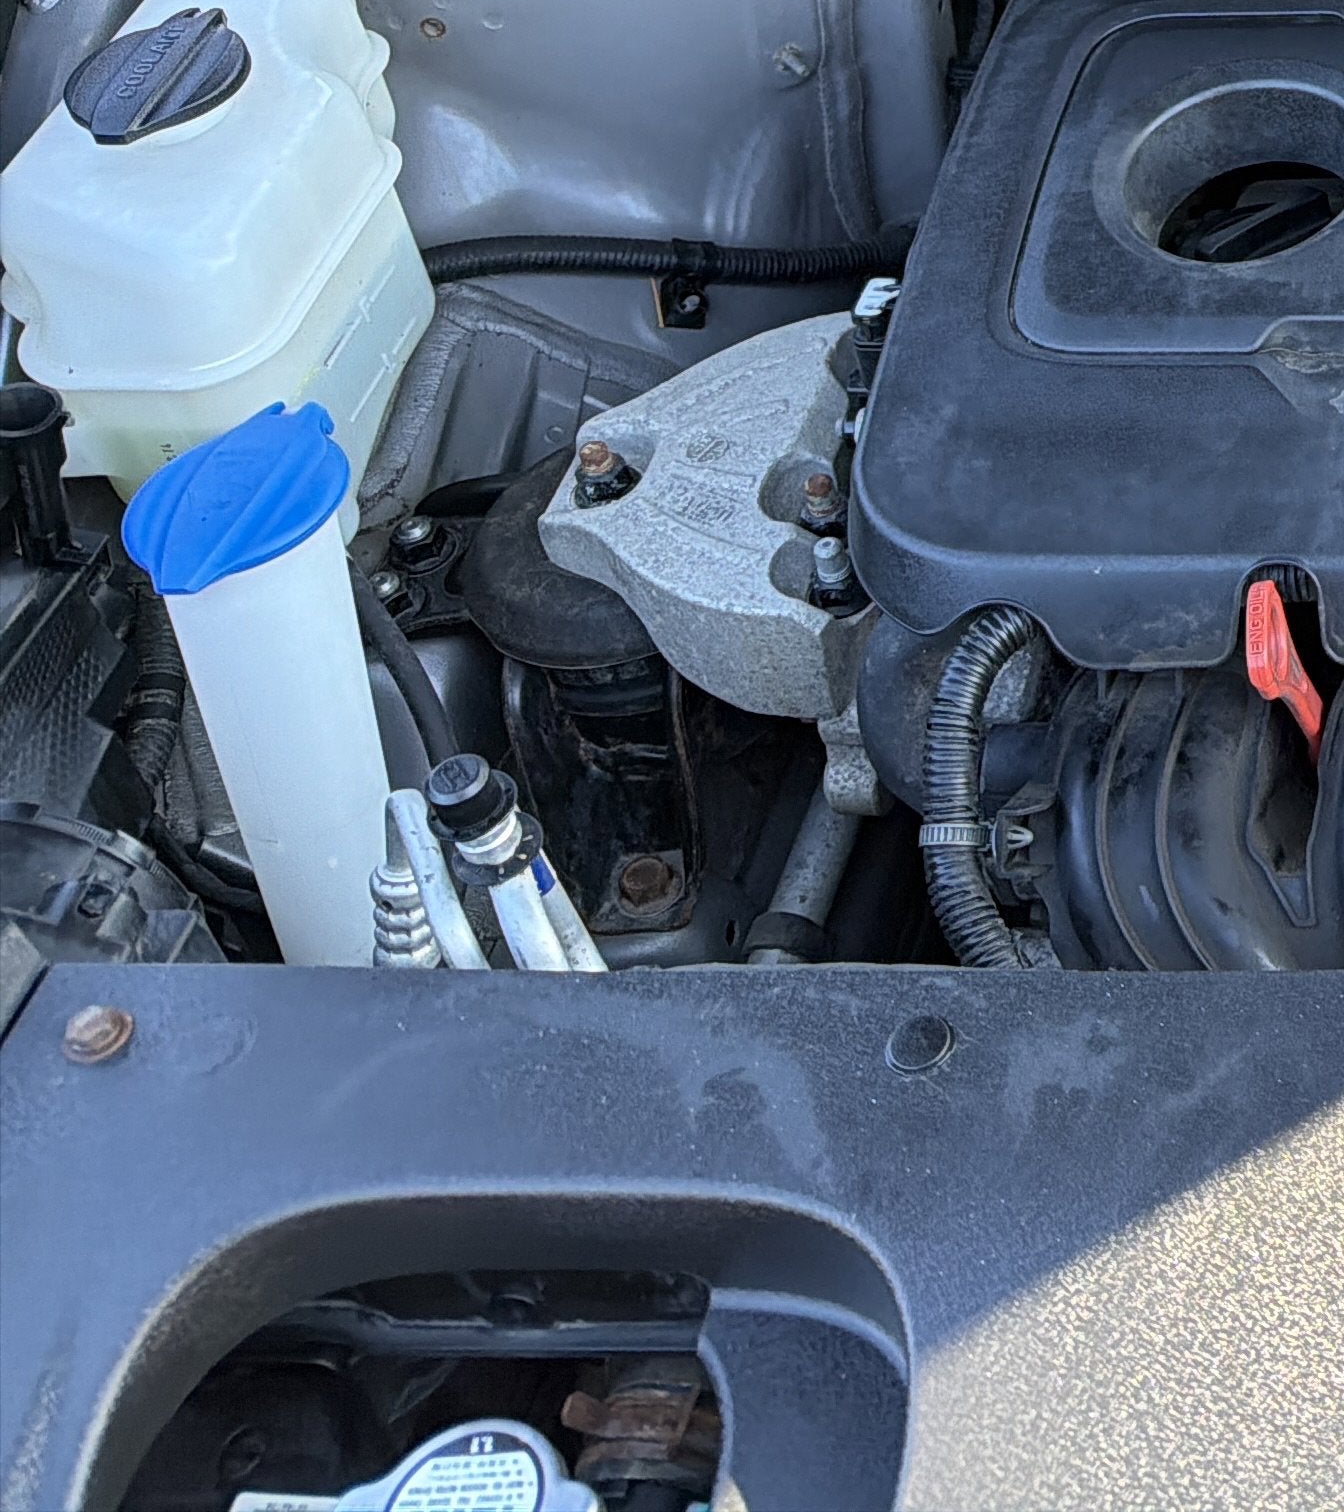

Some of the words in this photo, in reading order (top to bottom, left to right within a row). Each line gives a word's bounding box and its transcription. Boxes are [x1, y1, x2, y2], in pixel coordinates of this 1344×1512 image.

[116, 24, 186, 99] COOLANT
[1248, 588, 1265, 616] OIL
[1248, 618, 1265, 656] ENG
